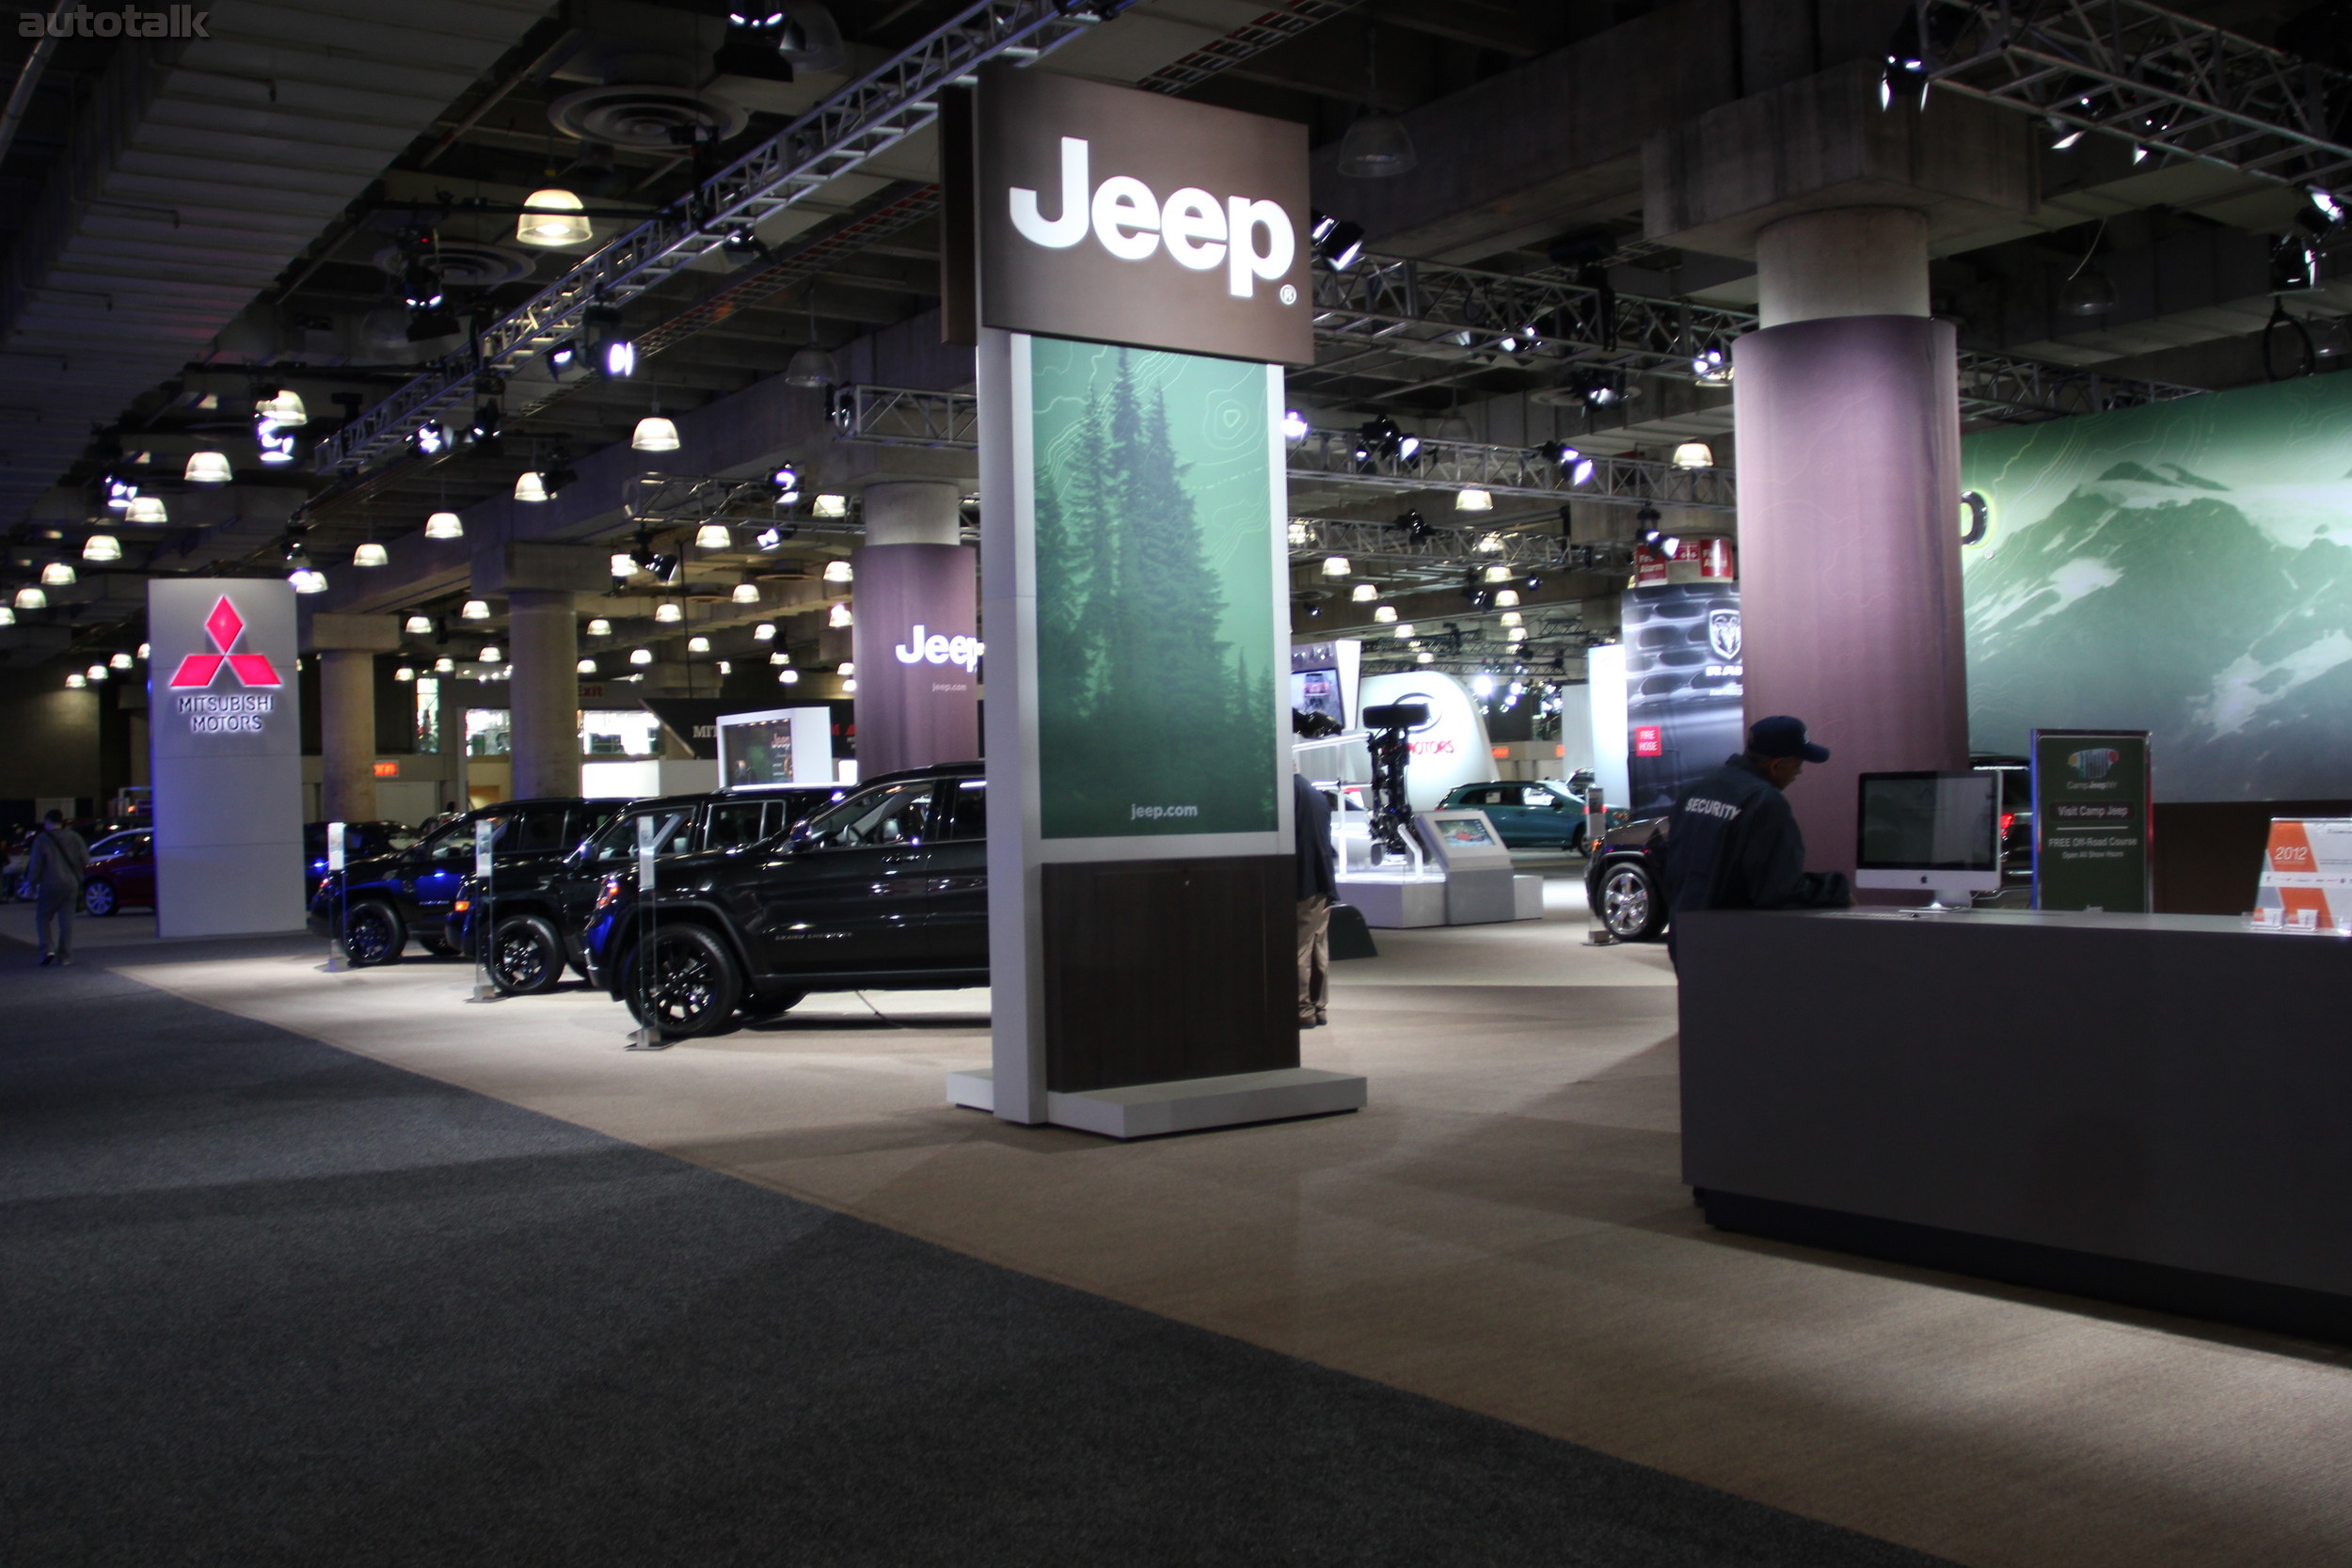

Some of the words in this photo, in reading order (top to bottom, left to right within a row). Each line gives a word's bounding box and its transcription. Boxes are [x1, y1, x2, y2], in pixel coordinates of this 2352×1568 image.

[1009, 136, 1295, 297] Jeep
[895, 624, 978, 673] Jeep
[179, 695, 274, 712] MITSUBISHI
[192, 715, 262, 732] MOTORS
[1640, 730, 1656, 739] FIRE
[1639, 741, 1658, 752] HOSE
[1130, 803, 1198, 820] jeep.com
[1685, 797, 1742, 821] SECURITY
[2058, 806, 2078, 816] Visit
[2080, 806, 2106, 818] Camp
[2107, 806, 2129, 817] Jeep
[2049, 839, 2072, 847] FREE
[2073, 838, 2107, 847] Off-Road
[2109, 837, 2138, 847] Course
[2274, 847, 2308, 860] 2012
